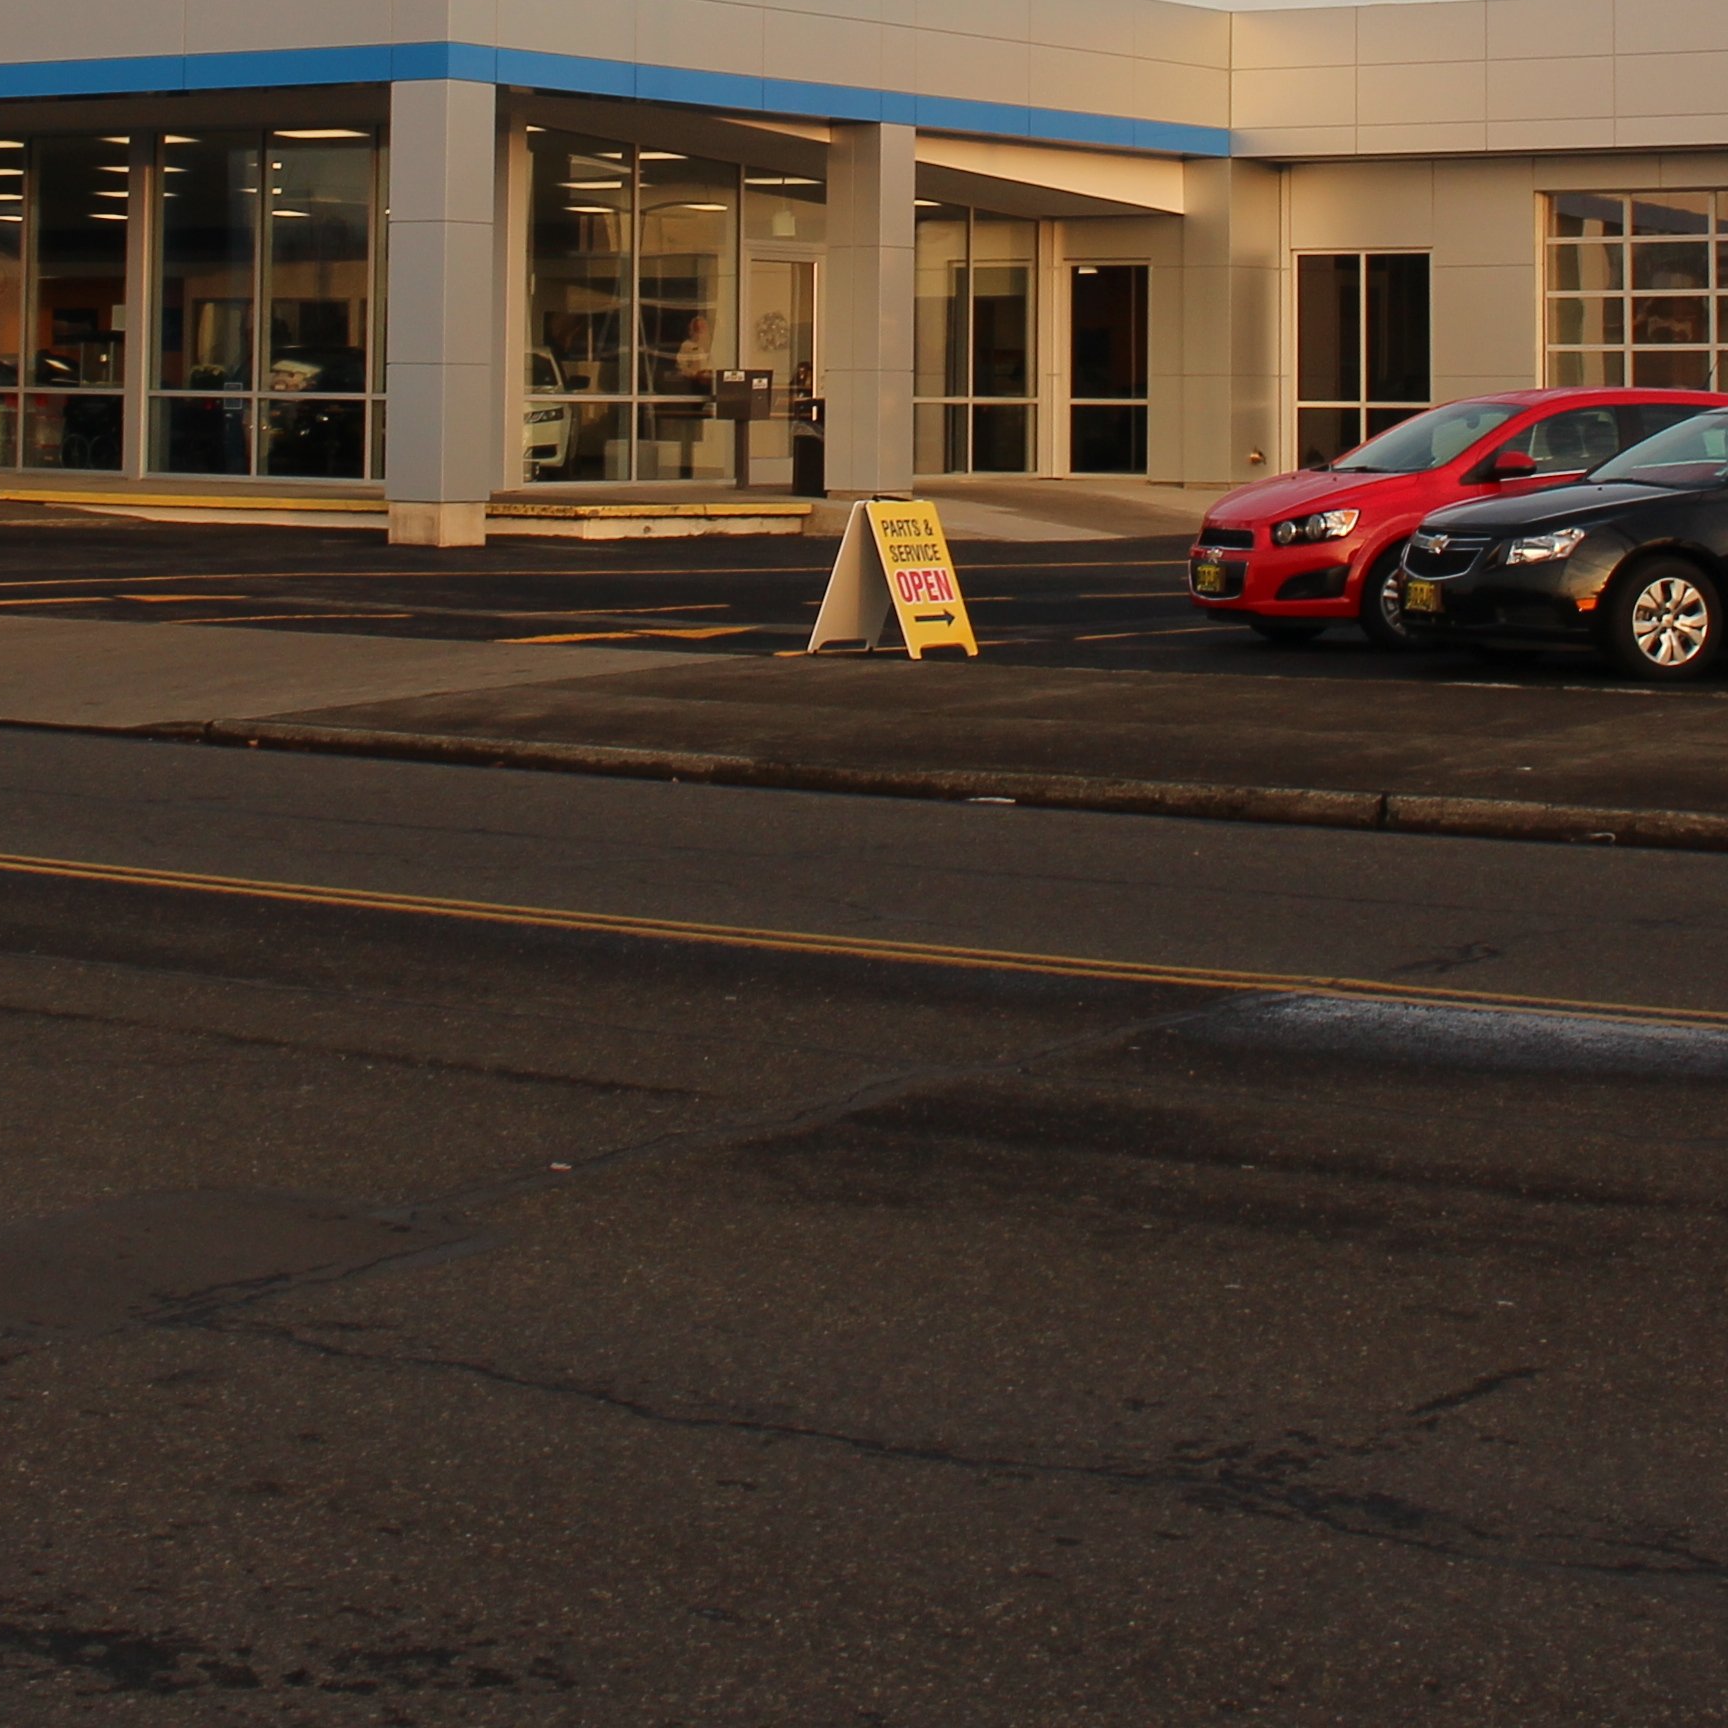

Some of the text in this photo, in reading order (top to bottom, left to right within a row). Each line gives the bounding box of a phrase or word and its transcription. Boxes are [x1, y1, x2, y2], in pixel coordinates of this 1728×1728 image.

[881, 519, 934, 537] PARTS &
[889, 543, 942, 563] SERVICE
[895, 569, 955, 604] OPEN
